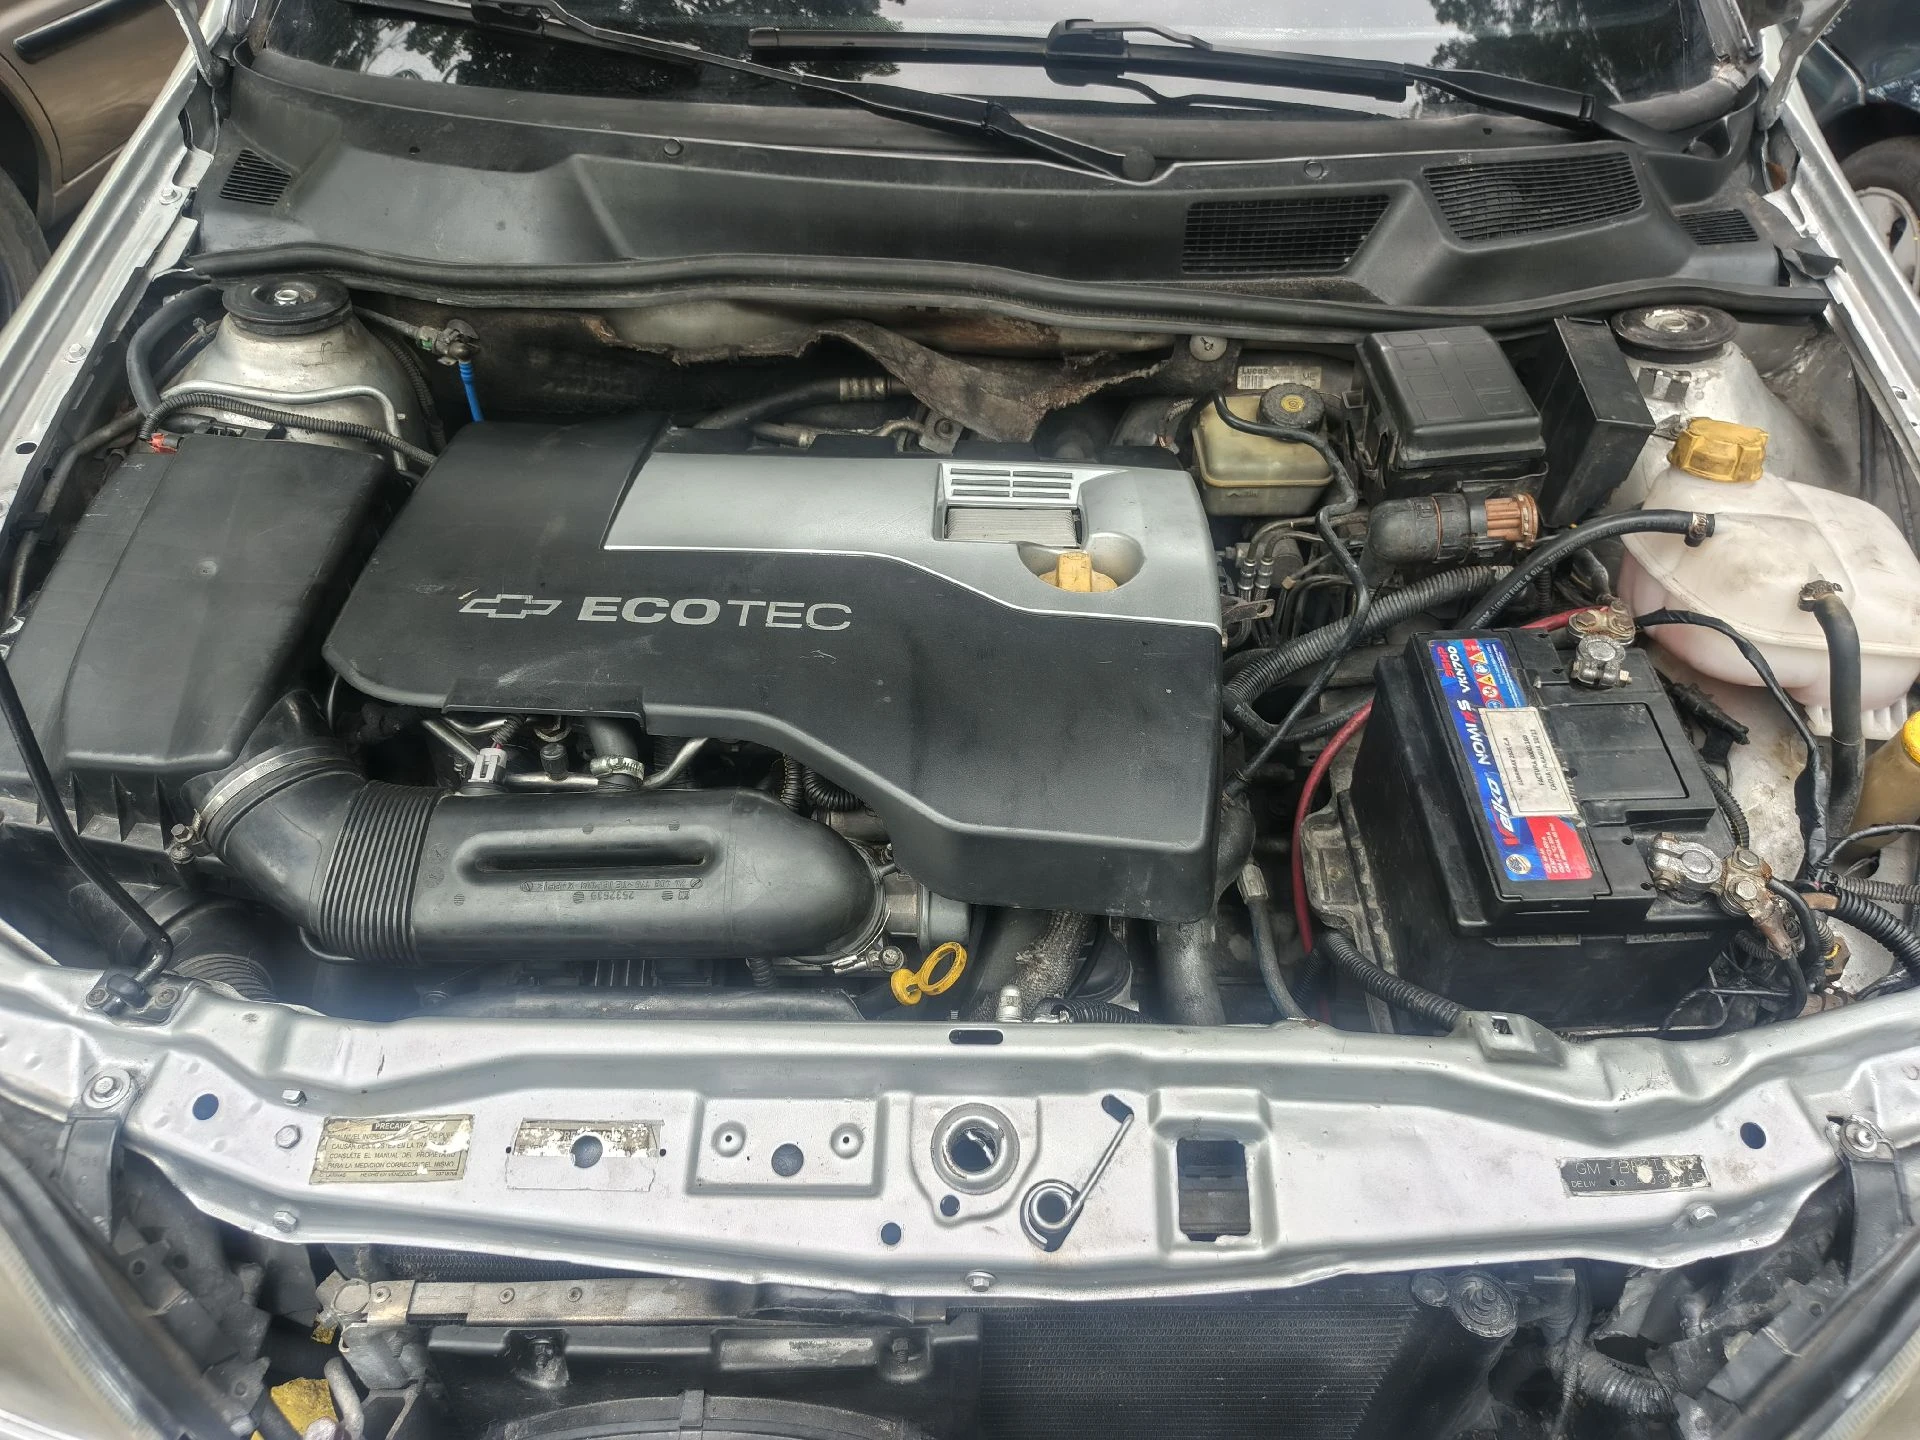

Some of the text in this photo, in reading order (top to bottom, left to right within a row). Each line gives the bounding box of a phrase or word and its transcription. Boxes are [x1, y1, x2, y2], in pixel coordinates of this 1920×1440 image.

[1509, 579, 1527, 595] FUEL
[1530, 563, 1544, 576] OIL
[577, 596, 852, 631] ECOTEC
[1447, 645, 1471, 693] VKN700
[1530, 759, 1546, 786] FACTURA
[330, 1152, 361, 1160] CONSULTE
[374, 1151, 399, 1159] MANUAL
[386, 1161, 419, 1169] CORRECTA
[1575, 1162, 1601, 1175] GM
